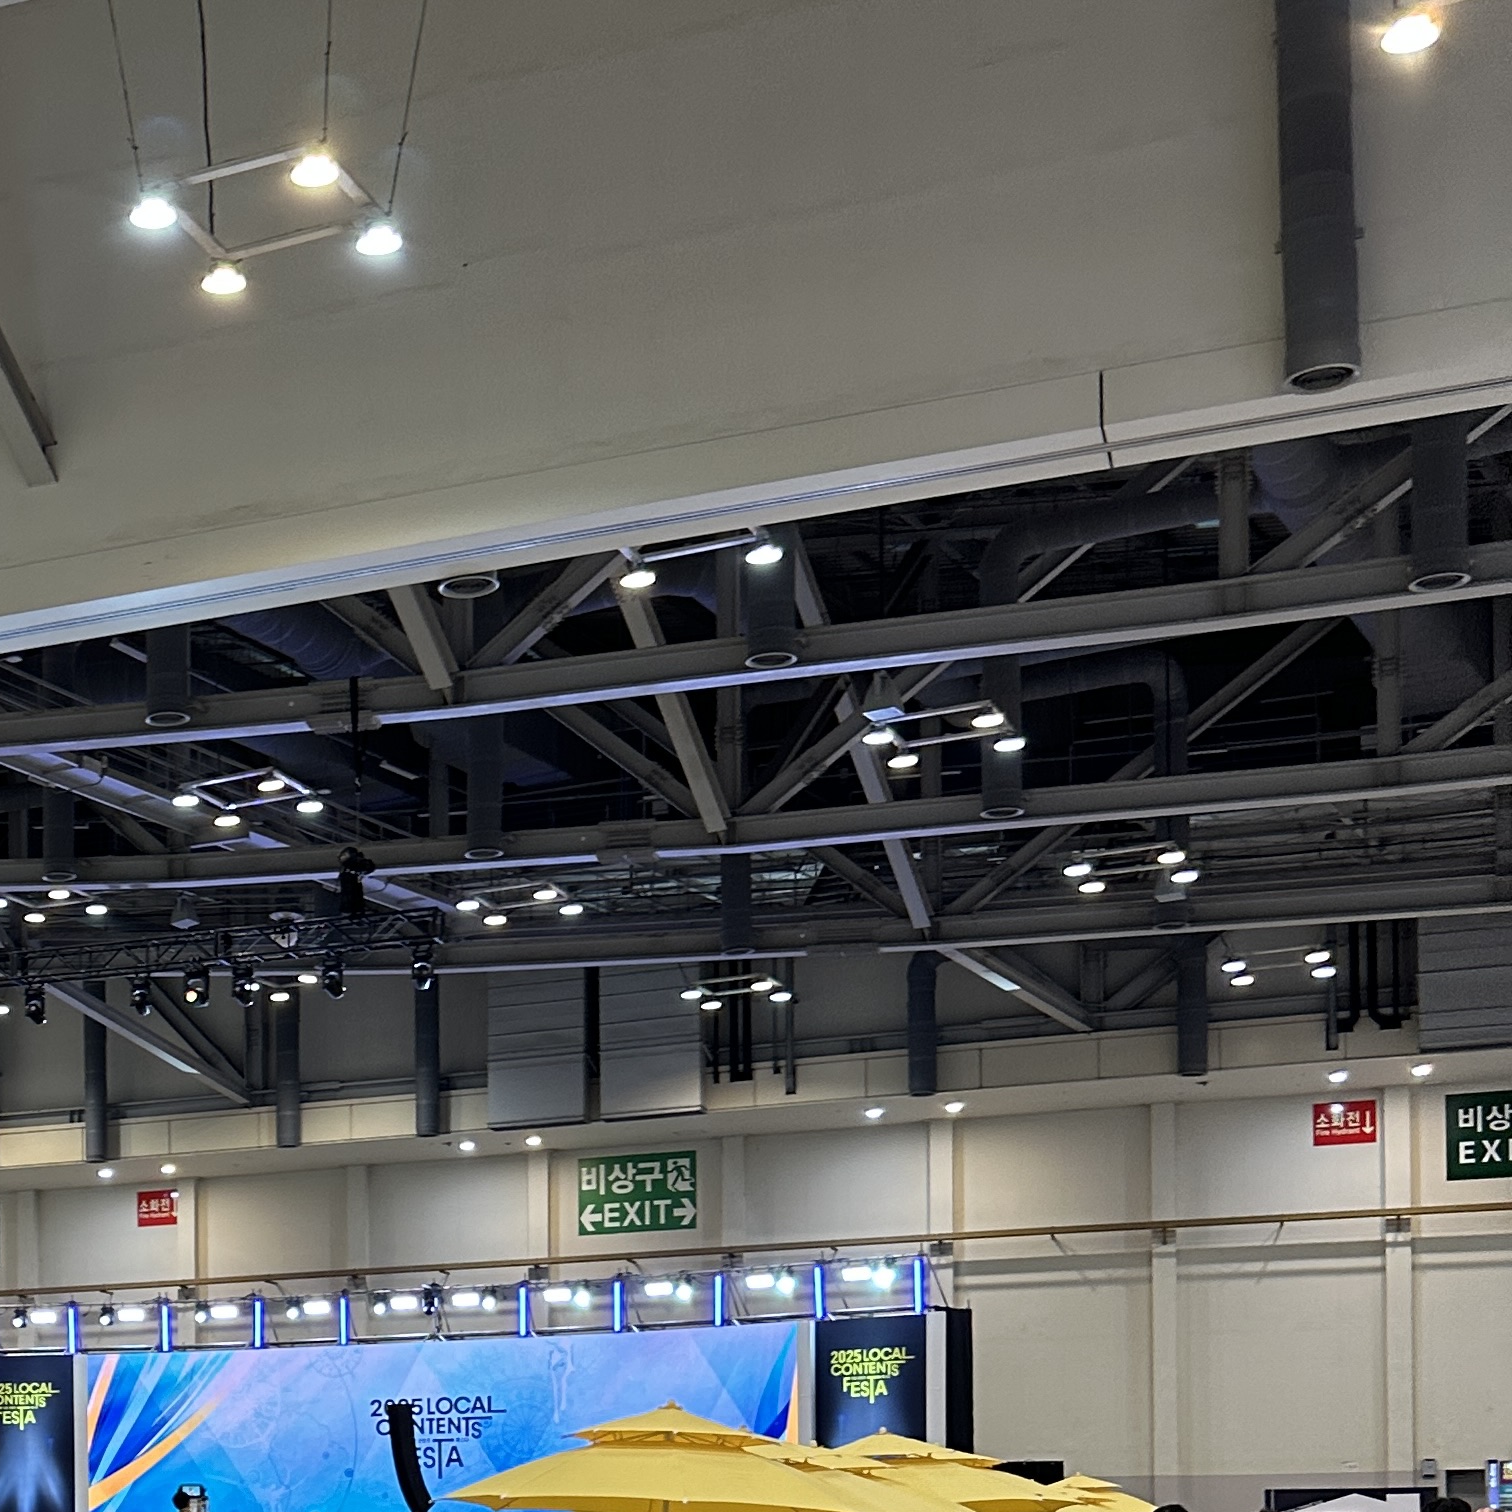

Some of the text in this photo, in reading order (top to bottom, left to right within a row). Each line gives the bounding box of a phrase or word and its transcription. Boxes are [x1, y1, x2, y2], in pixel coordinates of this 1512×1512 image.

[1458, 1103, 1512, 1133] 비상
[581, 1161, 664, 1195] 비상구
[603, 1199, 672, 1228] EXIT
[830, 1347, 915, 1364] 2025 LOCAL
[830, 1360, 906, 1377] CONTENTS
[13, 1382, 60, 1394] LOCAL
[842, 1375, 888, 1404] FESTA
[427, 1396, 507, 1415] LOCAL
[376, 1416, 493, 1439] CNTENTS
[416, 1438, 464, 1480] STA
